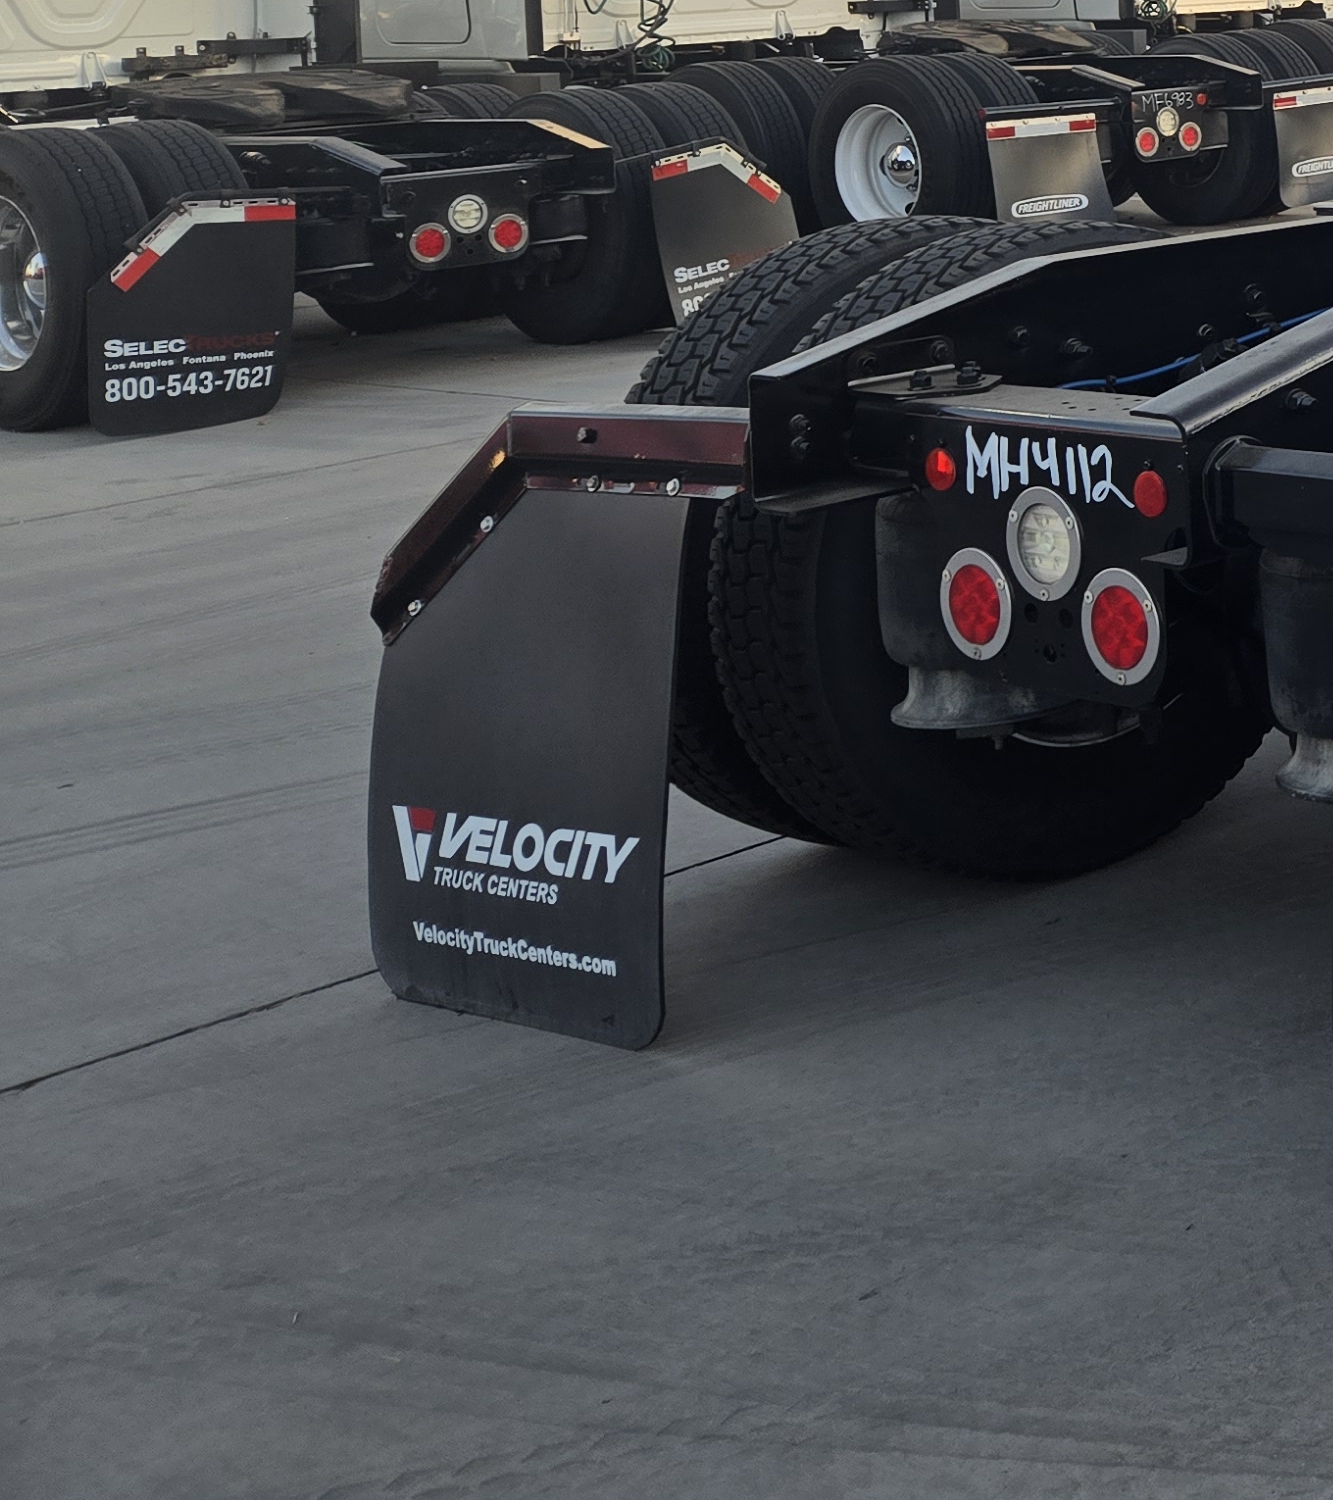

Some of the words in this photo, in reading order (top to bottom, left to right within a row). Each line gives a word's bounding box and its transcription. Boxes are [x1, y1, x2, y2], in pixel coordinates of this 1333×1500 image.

[1141, 92, 1194, 112] MF6983
[1018, 197, 1081, 214] FREIGHTLINER
[105, 362, 126, 372] Los
[128, 358, 175, 371] Angeles
[182, 354, 227, 365] Fontana
[233, 350, 275, 361] Phoenix
[965, 425, 1135, 509] MH4112
[438, 811, 641, 884] VELOCITY
[433, 866, 485, 894] TRUCK
[487, 876, 559, 905] CENTERS
[412, 920, 618, 977] VelocityTruckCenters.com
